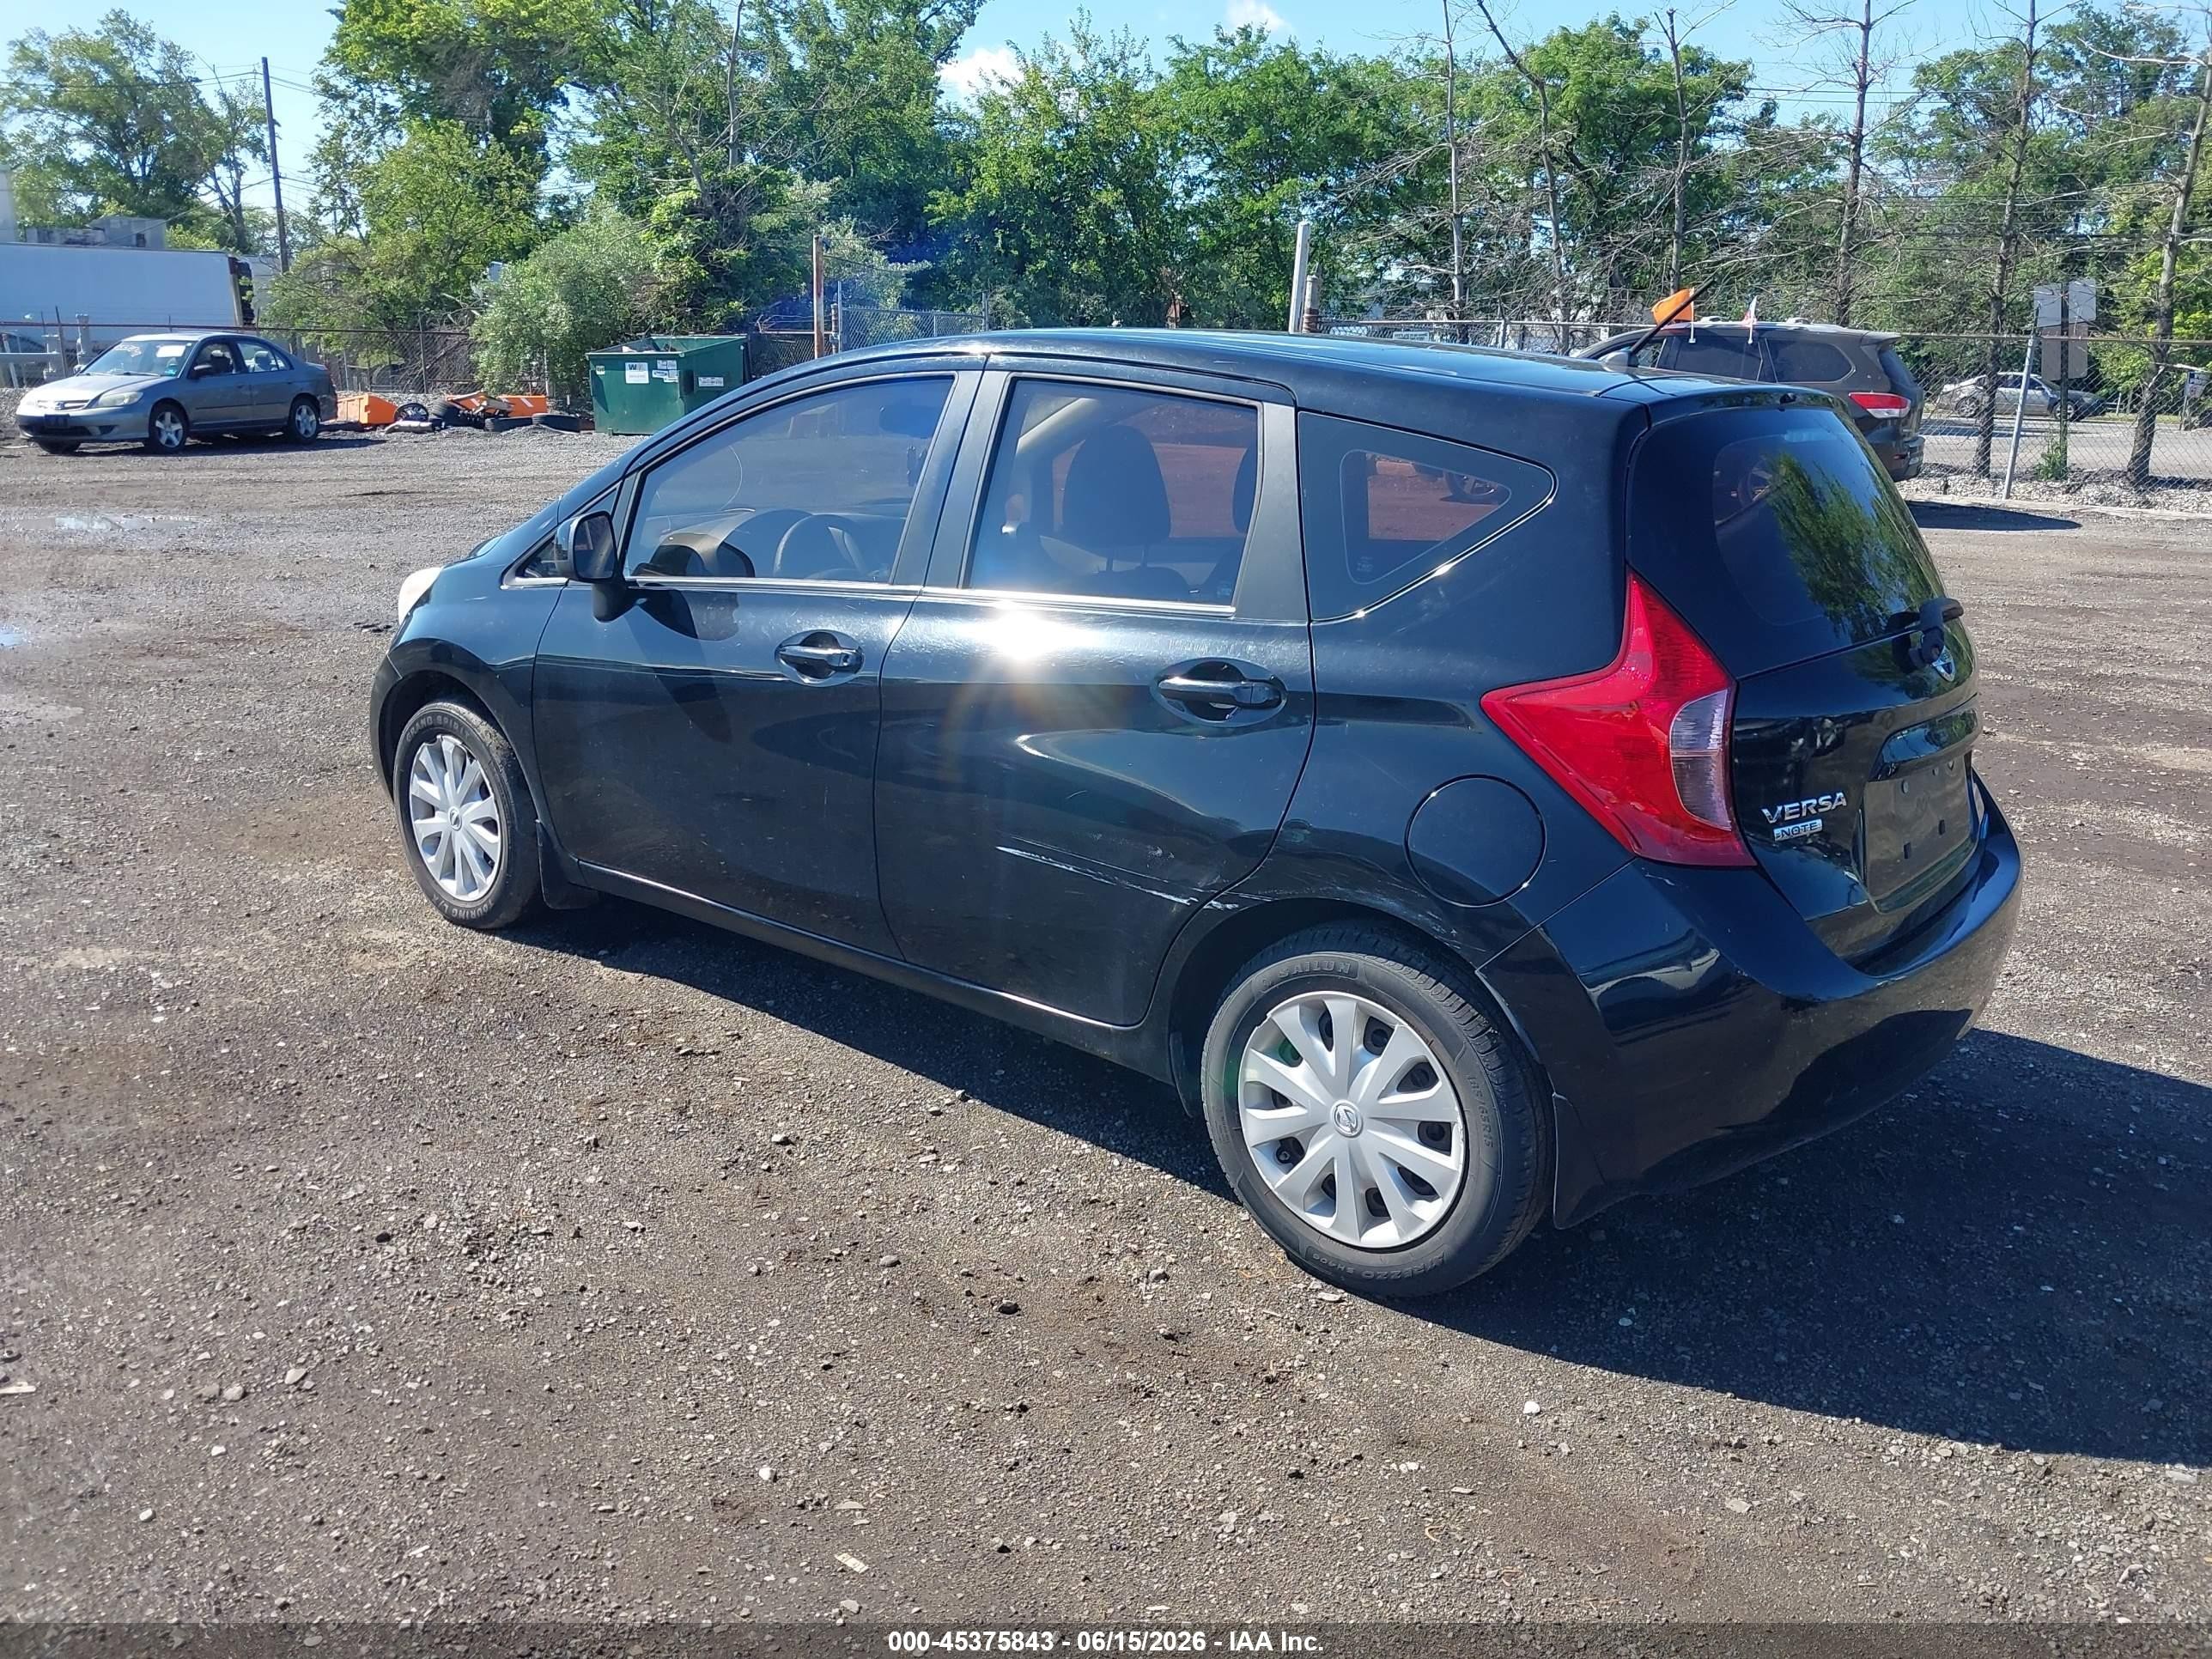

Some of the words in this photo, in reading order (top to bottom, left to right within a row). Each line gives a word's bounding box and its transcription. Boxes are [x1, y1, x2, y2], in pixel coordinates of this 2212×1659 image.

[406, 715, 433, 742] GRAND
[1761, 792, 1847, 823] VERSA
[1780, 822, 1819, 838] NOTE
[452, 898, 495, 920] TOURING
[1277, 961, 1351, 978] SAILUN
